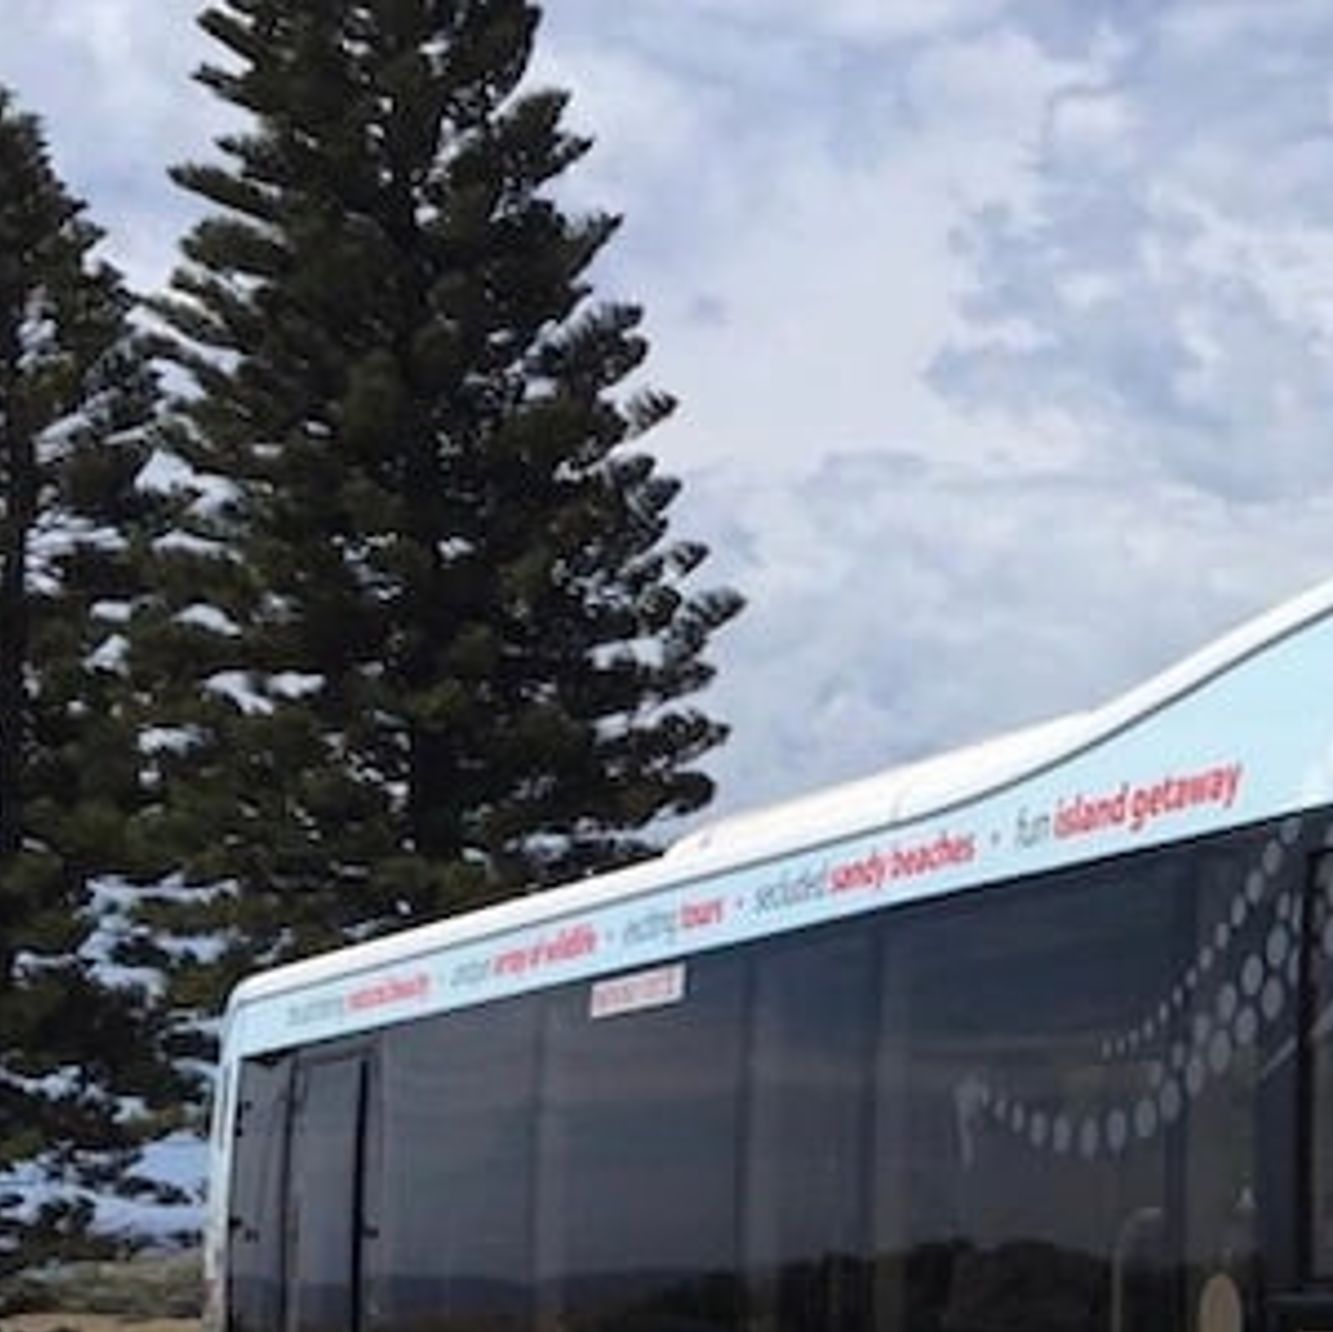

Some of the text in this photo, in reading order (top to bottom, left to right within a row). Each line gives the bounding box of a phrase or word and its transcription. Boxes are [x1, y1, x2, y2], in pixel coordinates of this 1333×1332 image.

[830, 847, 885, 892] sandy
[890, 832, 976, 878] beaches
[1016, 806, 1050, 848] fun
[1053, 782, 1129, 838] island
[1129, 764, 1243, 832] getaway
